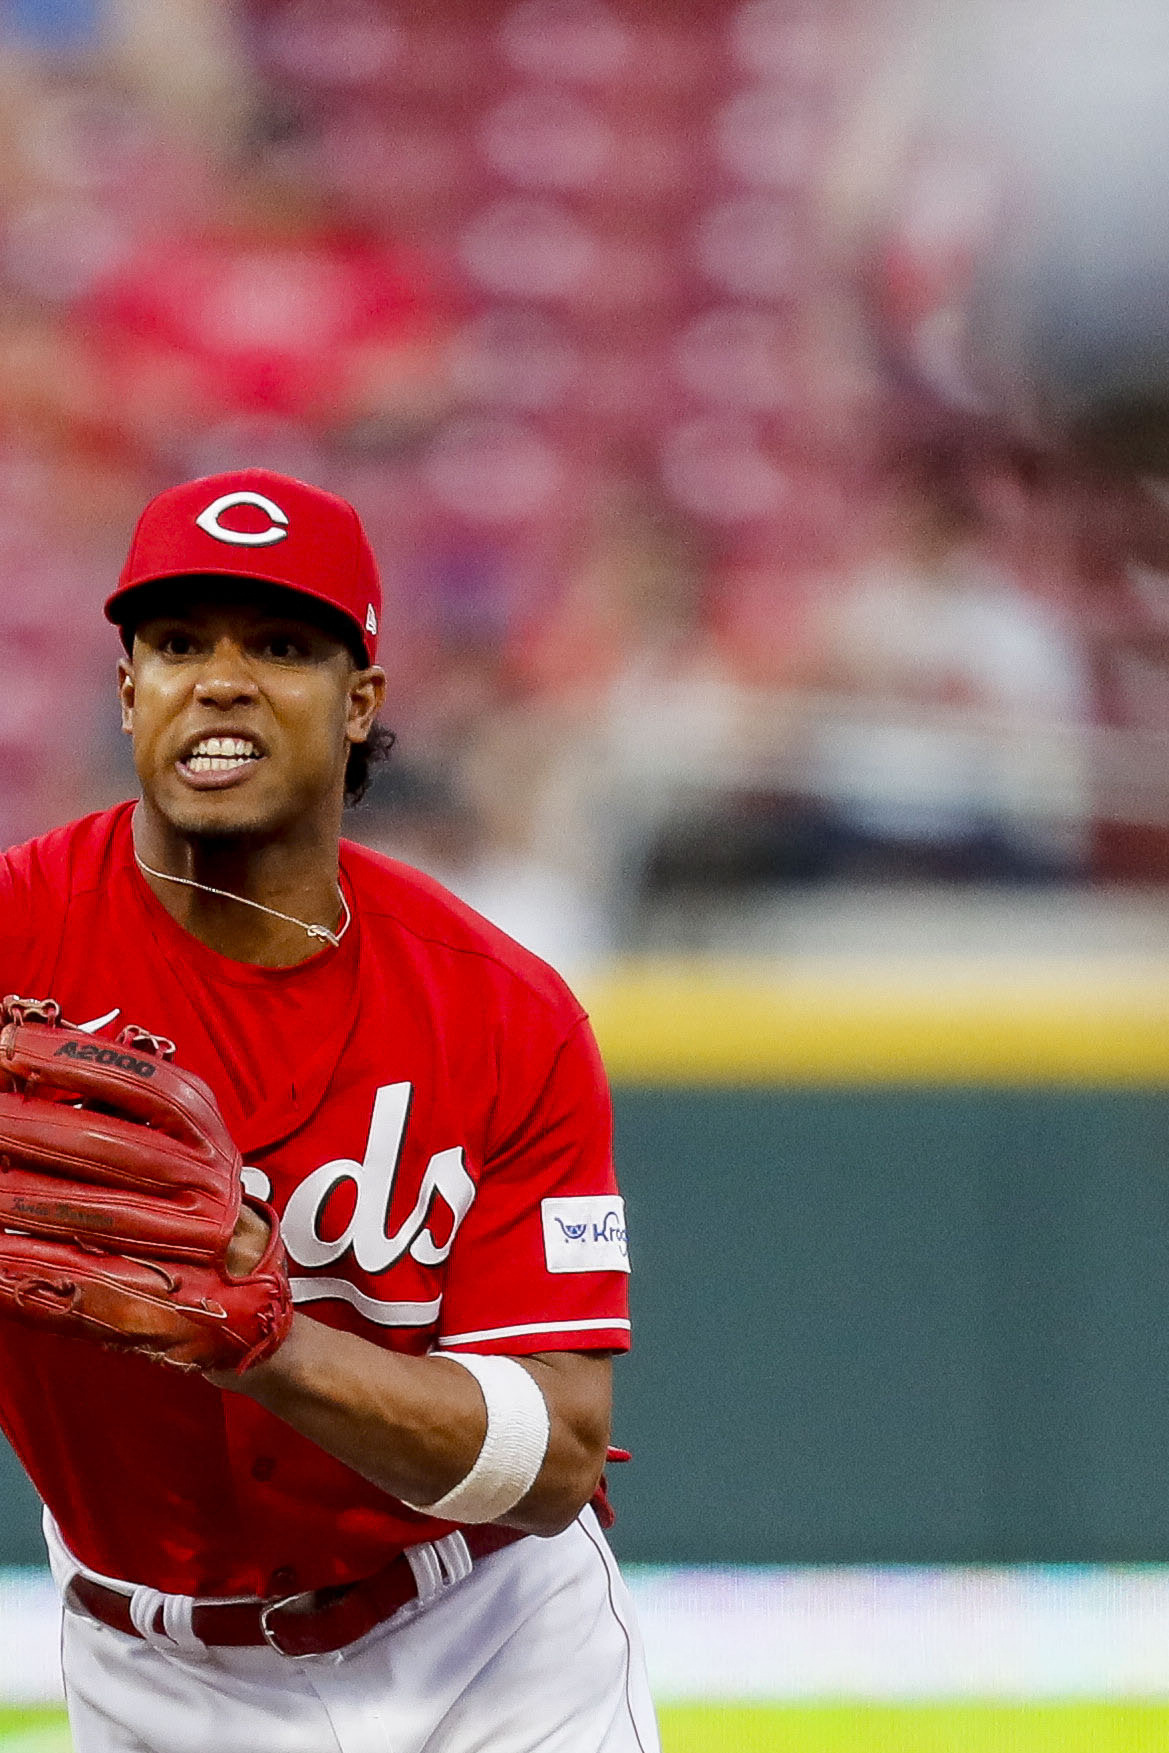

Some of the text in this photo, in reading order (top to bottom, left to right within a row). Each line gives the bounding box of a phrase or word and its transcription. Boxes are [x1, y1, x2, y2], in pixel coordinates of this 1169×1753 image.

[196, 491, 289, 548] C
[54, 1041, 156, 1078] A2000
[240, 1081, 476, 1274] ds
